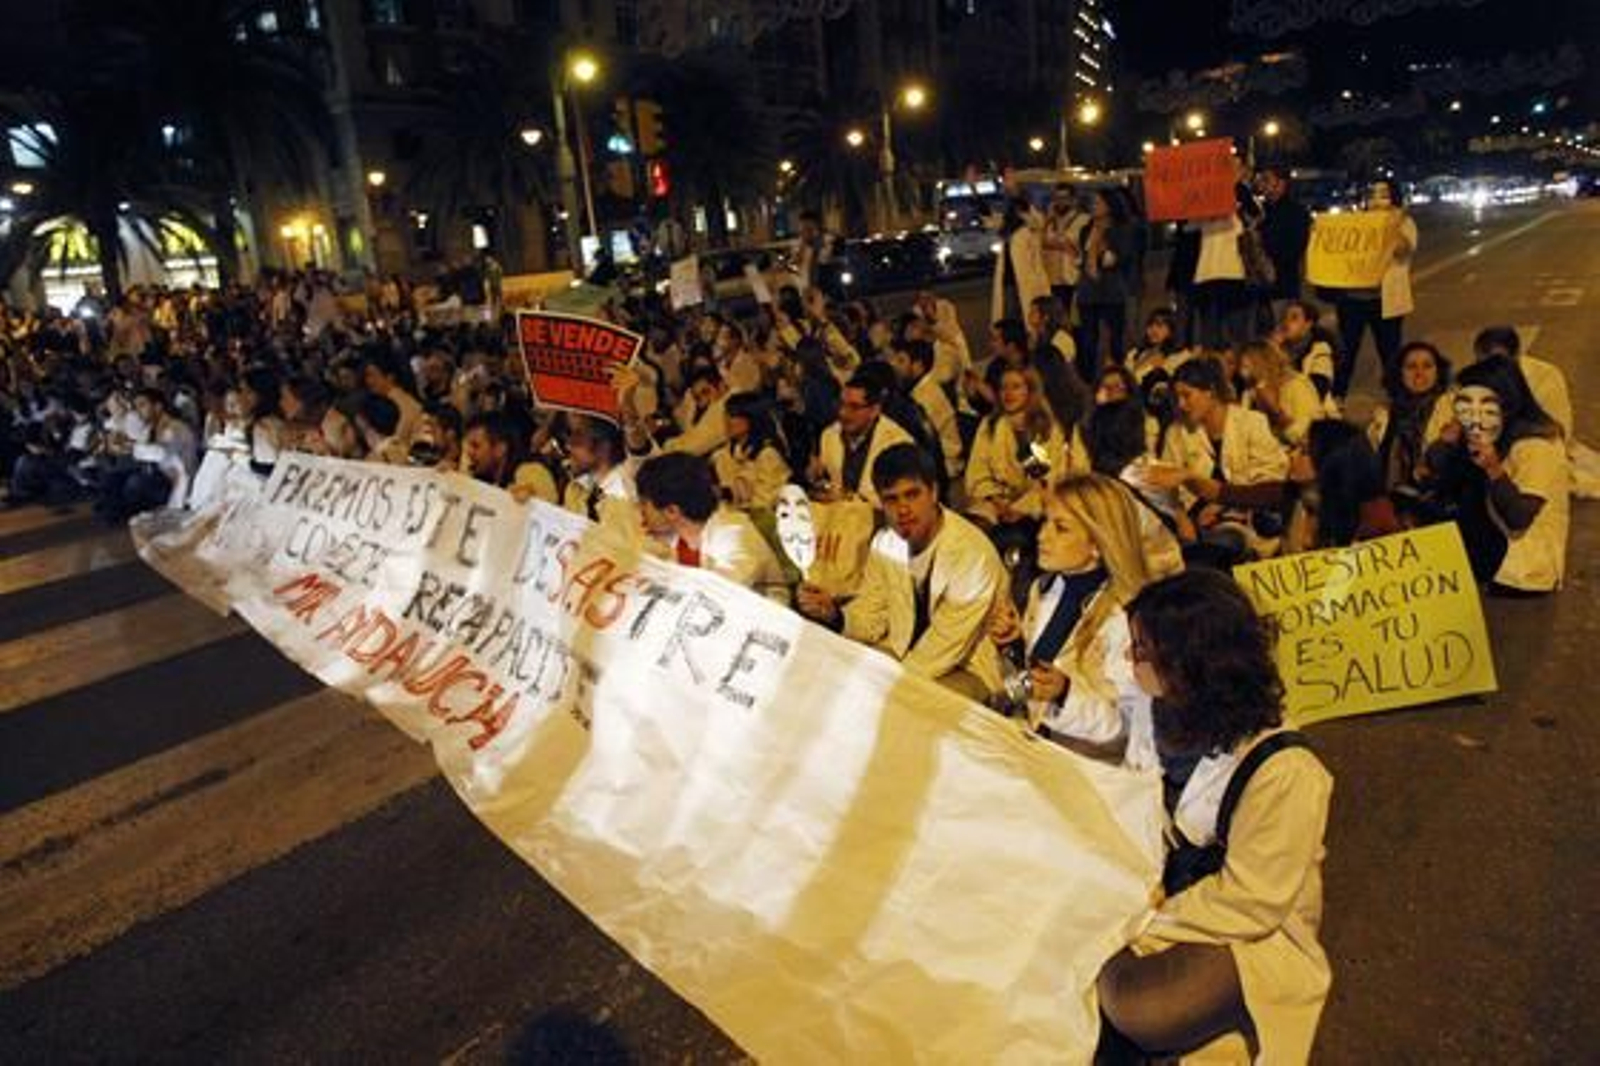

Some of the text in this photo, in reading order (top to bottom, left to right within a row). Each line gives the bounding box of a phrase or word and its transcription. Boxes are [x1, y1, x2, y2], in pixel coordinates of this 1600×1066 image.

[549, 319, 634, 361] VENDE
[1249, 537, 1421, 602] NUESTRA
[512, 519, 790, 709] DESASTRE
[1295, 612, 1419, 666] ES TU
[1296, 629, 1475, 713] SALUD
